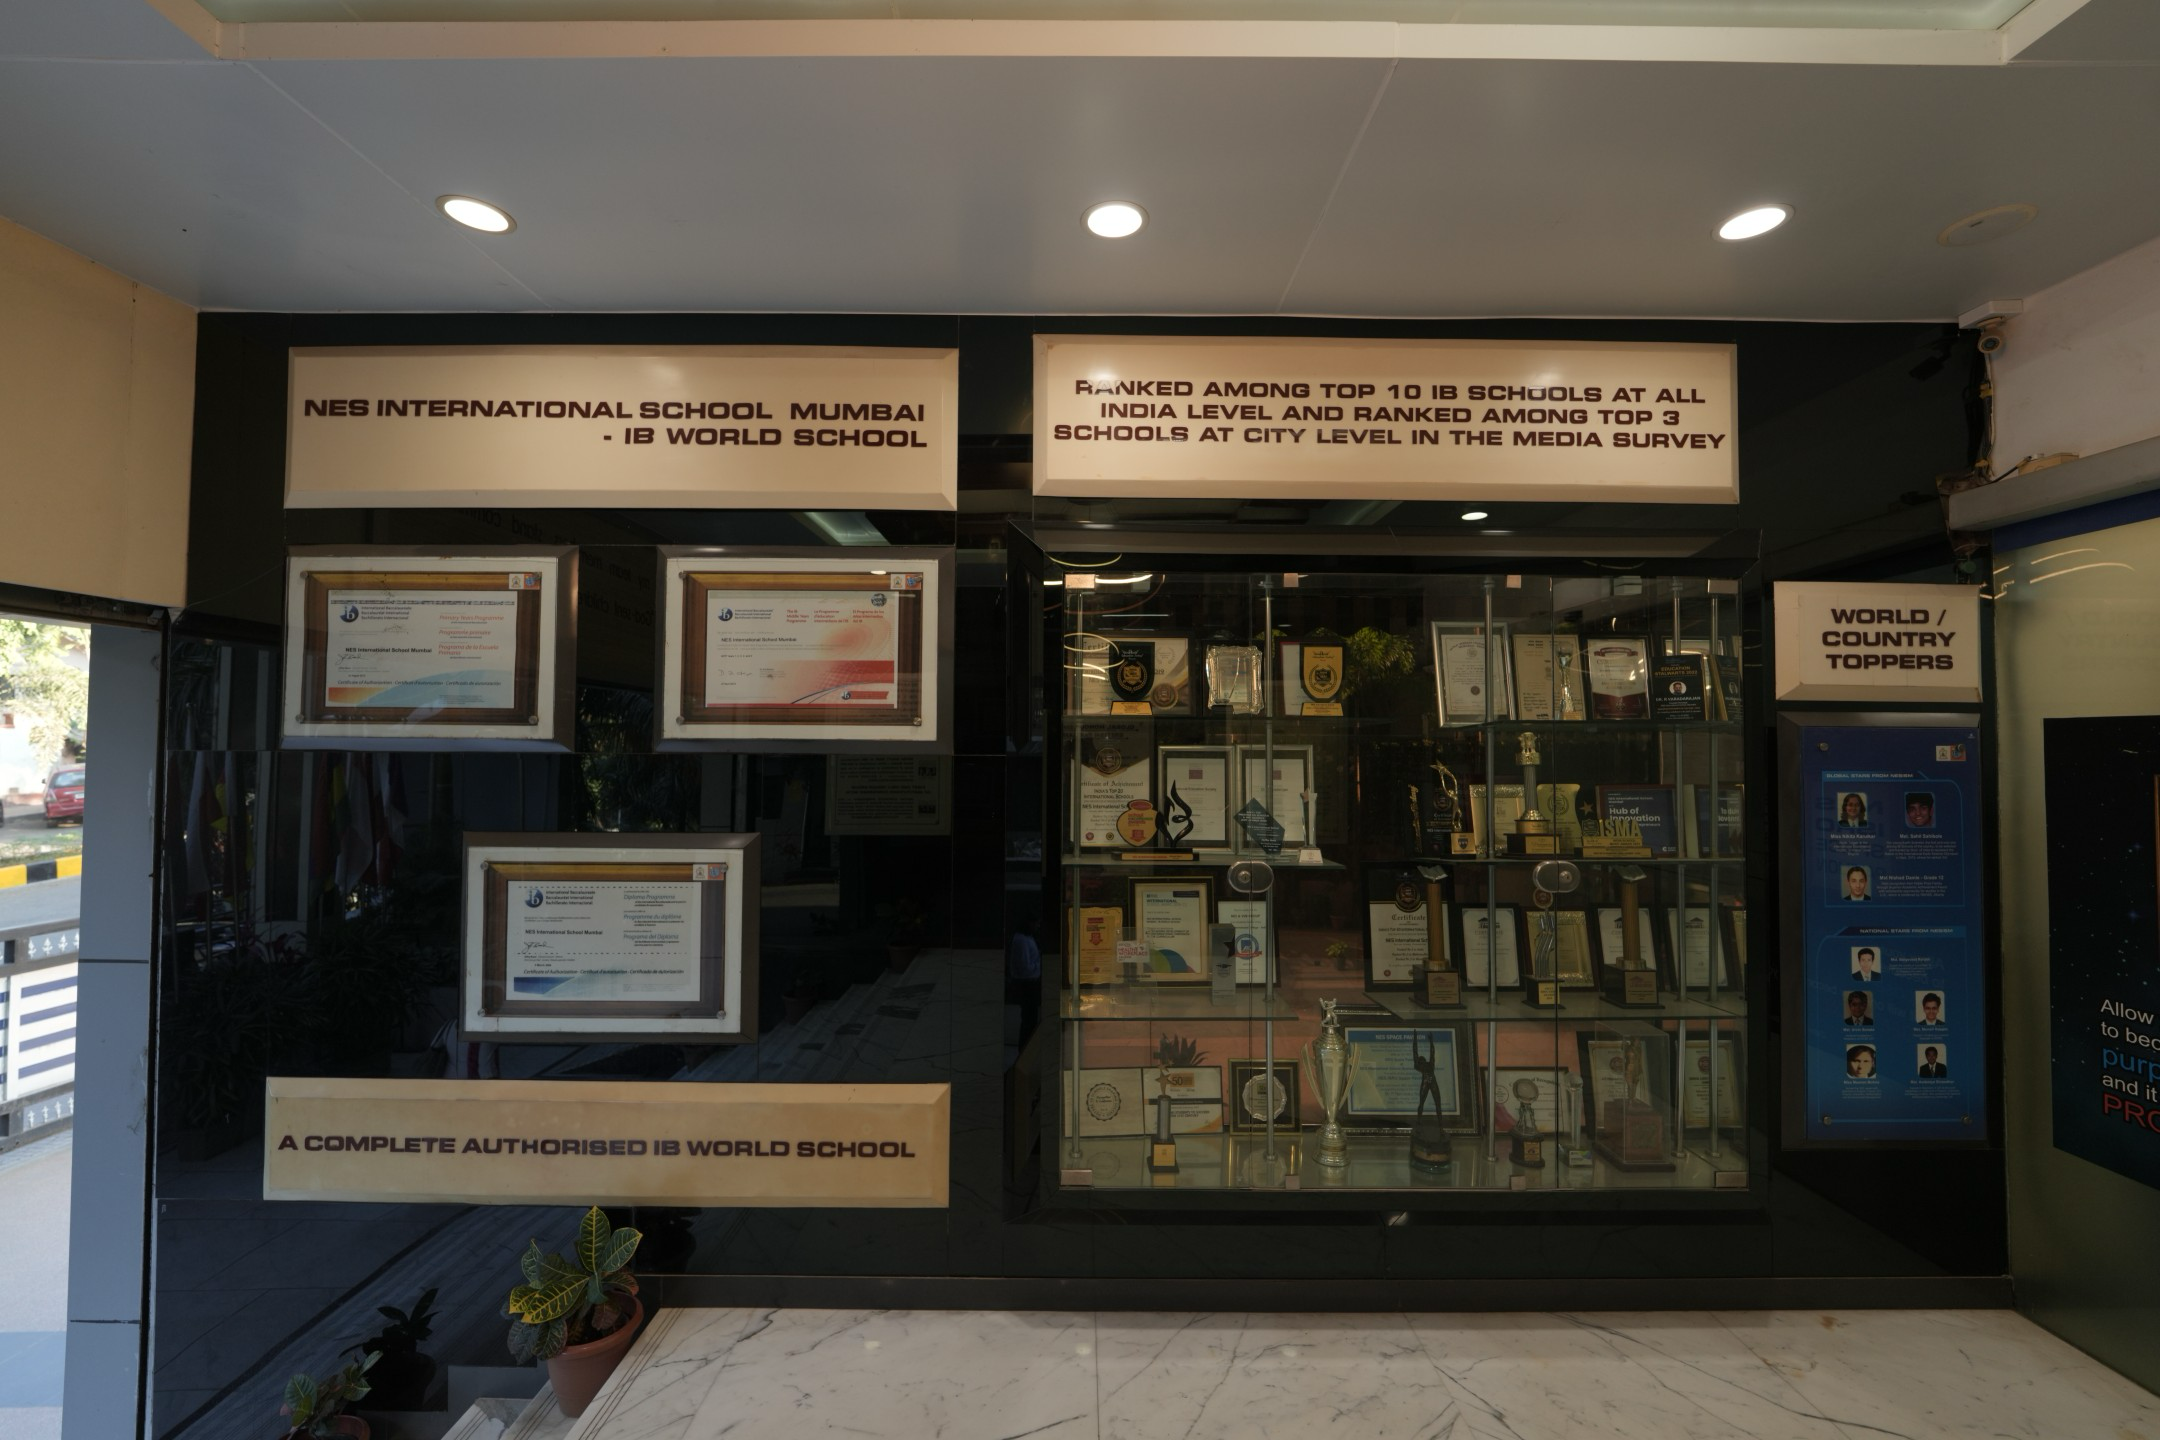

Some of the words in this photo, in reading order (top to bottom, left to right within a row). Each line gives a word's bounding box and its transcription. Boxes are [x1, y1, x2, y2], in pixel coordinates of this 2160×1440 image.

[1075, 380, 1193, 397] RANKED
[1203, 381, 1310, 398] AMONG
[1320, 384, 1376, 398] TOP
[1387, 385, 1421, 400] 10
[1432, 385, 1458, 400] IB
[1468, 385, 1602, 402] SCHOOLS
[1612, 387, 1646, 402] AT
[1656, 388, 1705, 403] ALL
[304, 399, 370, 416] NES
[377, 400, 632, 419] INTERNATIONAL
[640, 402, 772, 420] SCHOOL
[791, 403, 924, 421] MUMBAI
[1100, 403, 1177, 419] INDIA
[1188, 404, 1272, 420] LEVEL
[1282, 405, 1343, 421] AND
[1354, 406, 1471, 423] RANKED
[1481, 408, 1588, 425] AMONG
[1597, 409, 1653, 425] TOP
[1663, 410, 1679, 425] 3
[624, 428, 654, 444] IB
[666, 428, 781, 445] WORLD
[794, 429, 926, 447] SCHOOL
[1054, 425, 1189, 441] SCHOOLS
[1200, 426, 1234, 442] AT
[1244, 428, 1304, 443] CITY
[1316, 428, 1402, 445] LEVEL
[1412, 429, 1440, 445] IN
[1449, 430, 1503, 446] THE
[1513, 431, 1602, 447] MEDIA
[1613, 432, 1726, 449] SURVEY
[1831, 608, 1929, 624] WORLD
[1937, 609, 1947, 626] /
[1822, 631, 1956, 647] COUNTRY
[1826, 654, 1953, 670] TOPPERS
[1609, 807, 1627, 815] Hub
[1629, 807, 1640, 815] of
[1599, 818, 1643, 838] ISMA
[2101, 999, 2154, 1025] Allow
[2101, 1021, 2119, 1038] to
[1172, 1076, 1184, 1086] 50
[2102, 1075, 2138, 1096] and
[2146, 1084, 2158, 1102] it
[278, 1136, 298, 1151] A
[304, 1136, 455, 1153] COMPLETE
[463, 1138, 647, 1155] AUTHORISED
[654, 1140, 680, 1156] IB
[687, 1140, 790, 1157] WORLD
[796, 1142, 914, 1158] SCHOOL
